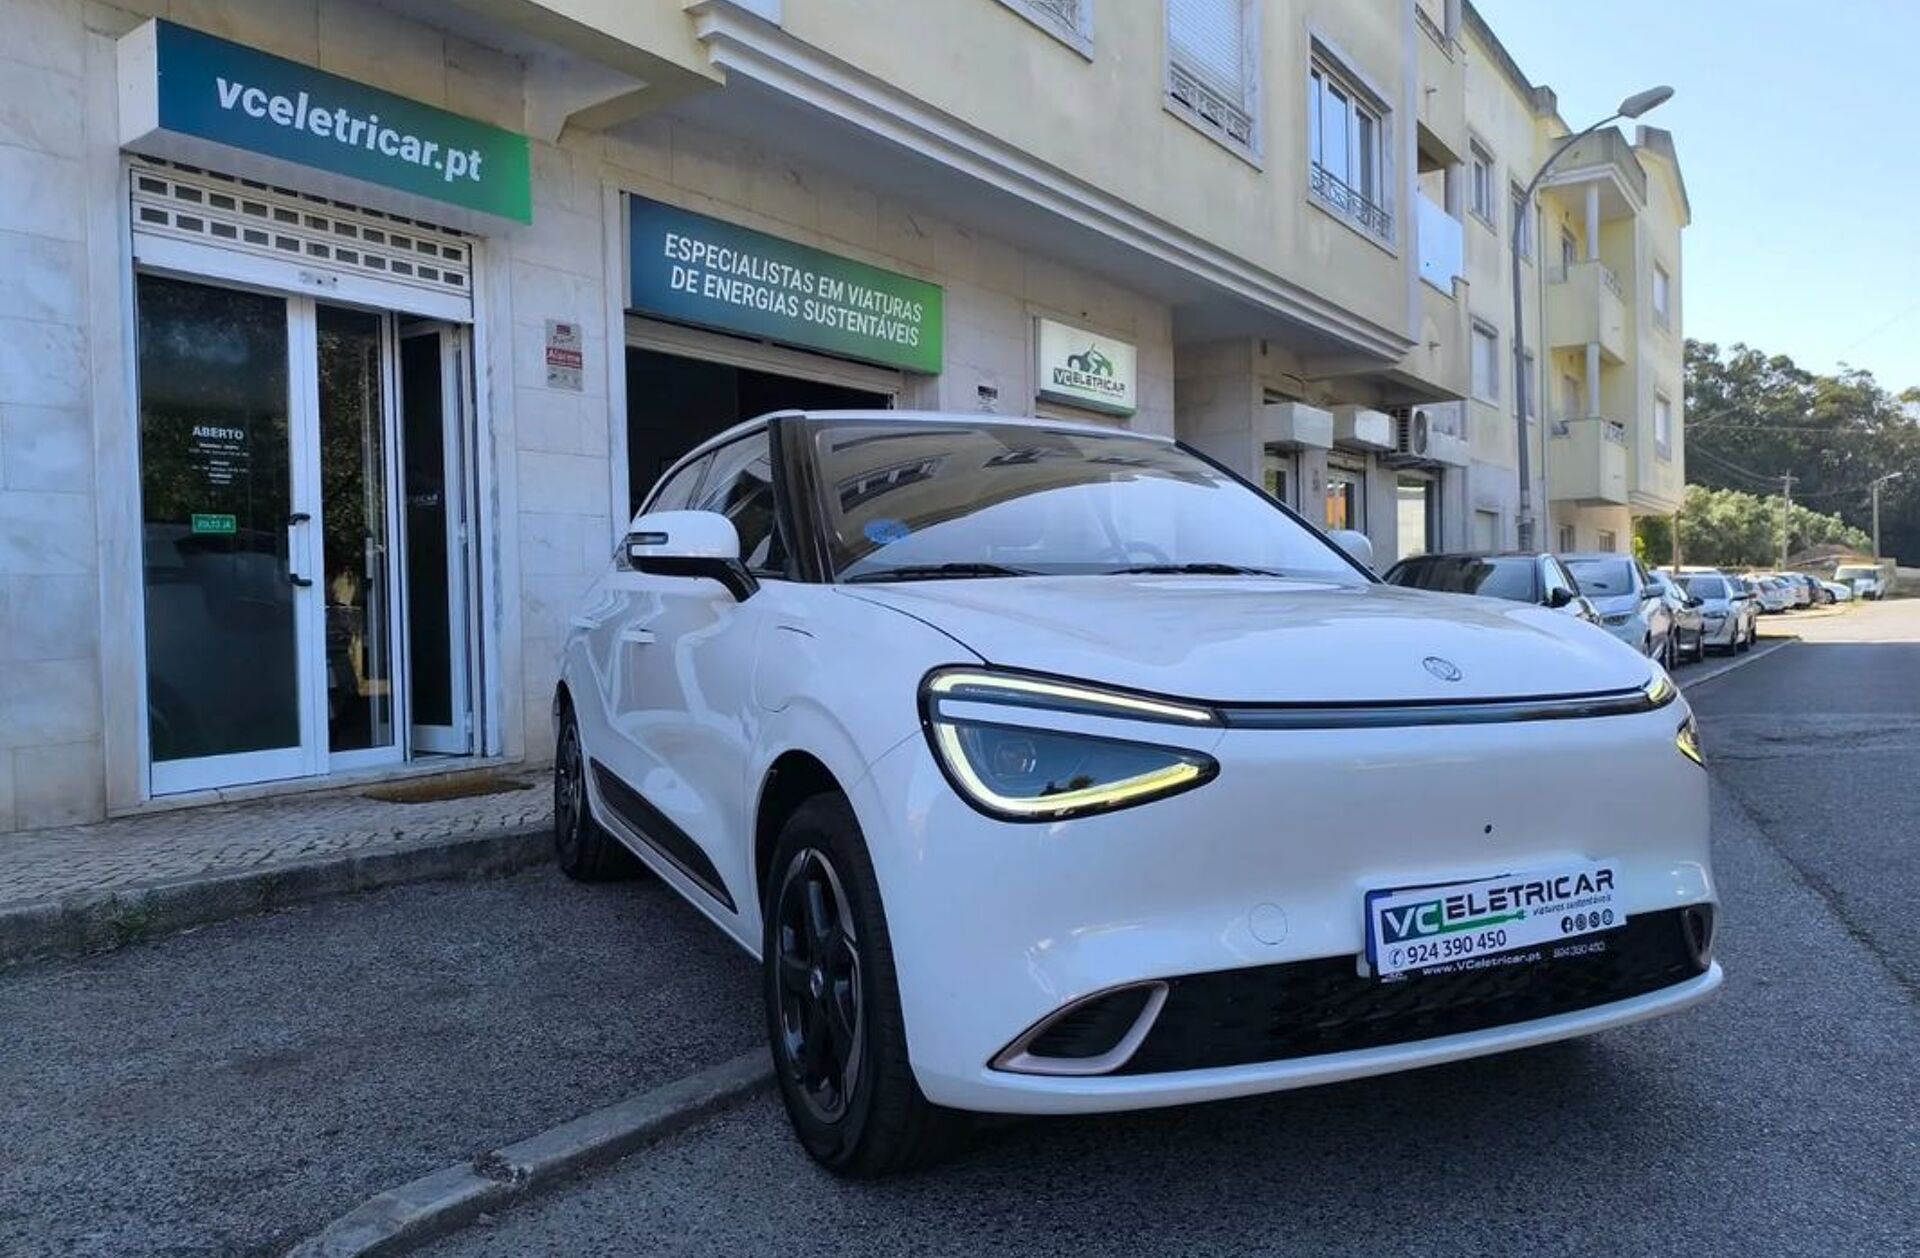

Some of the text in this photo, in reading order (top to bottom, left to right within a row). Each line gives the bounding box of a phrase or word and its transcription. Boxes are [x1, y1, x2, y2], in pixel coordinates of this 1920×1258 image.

[216, 77, 482, 182] vceletricar.pt
[665, 232, 922, 323] ESPECIALISTAS EM VIATURAS
[671, 265, 920, 347] DE ENERGIAS SUSTENTÁVEIS
[192, 426, 244, 440] ABERTO
[1407, 929, 1506, 965] 924 390 450
